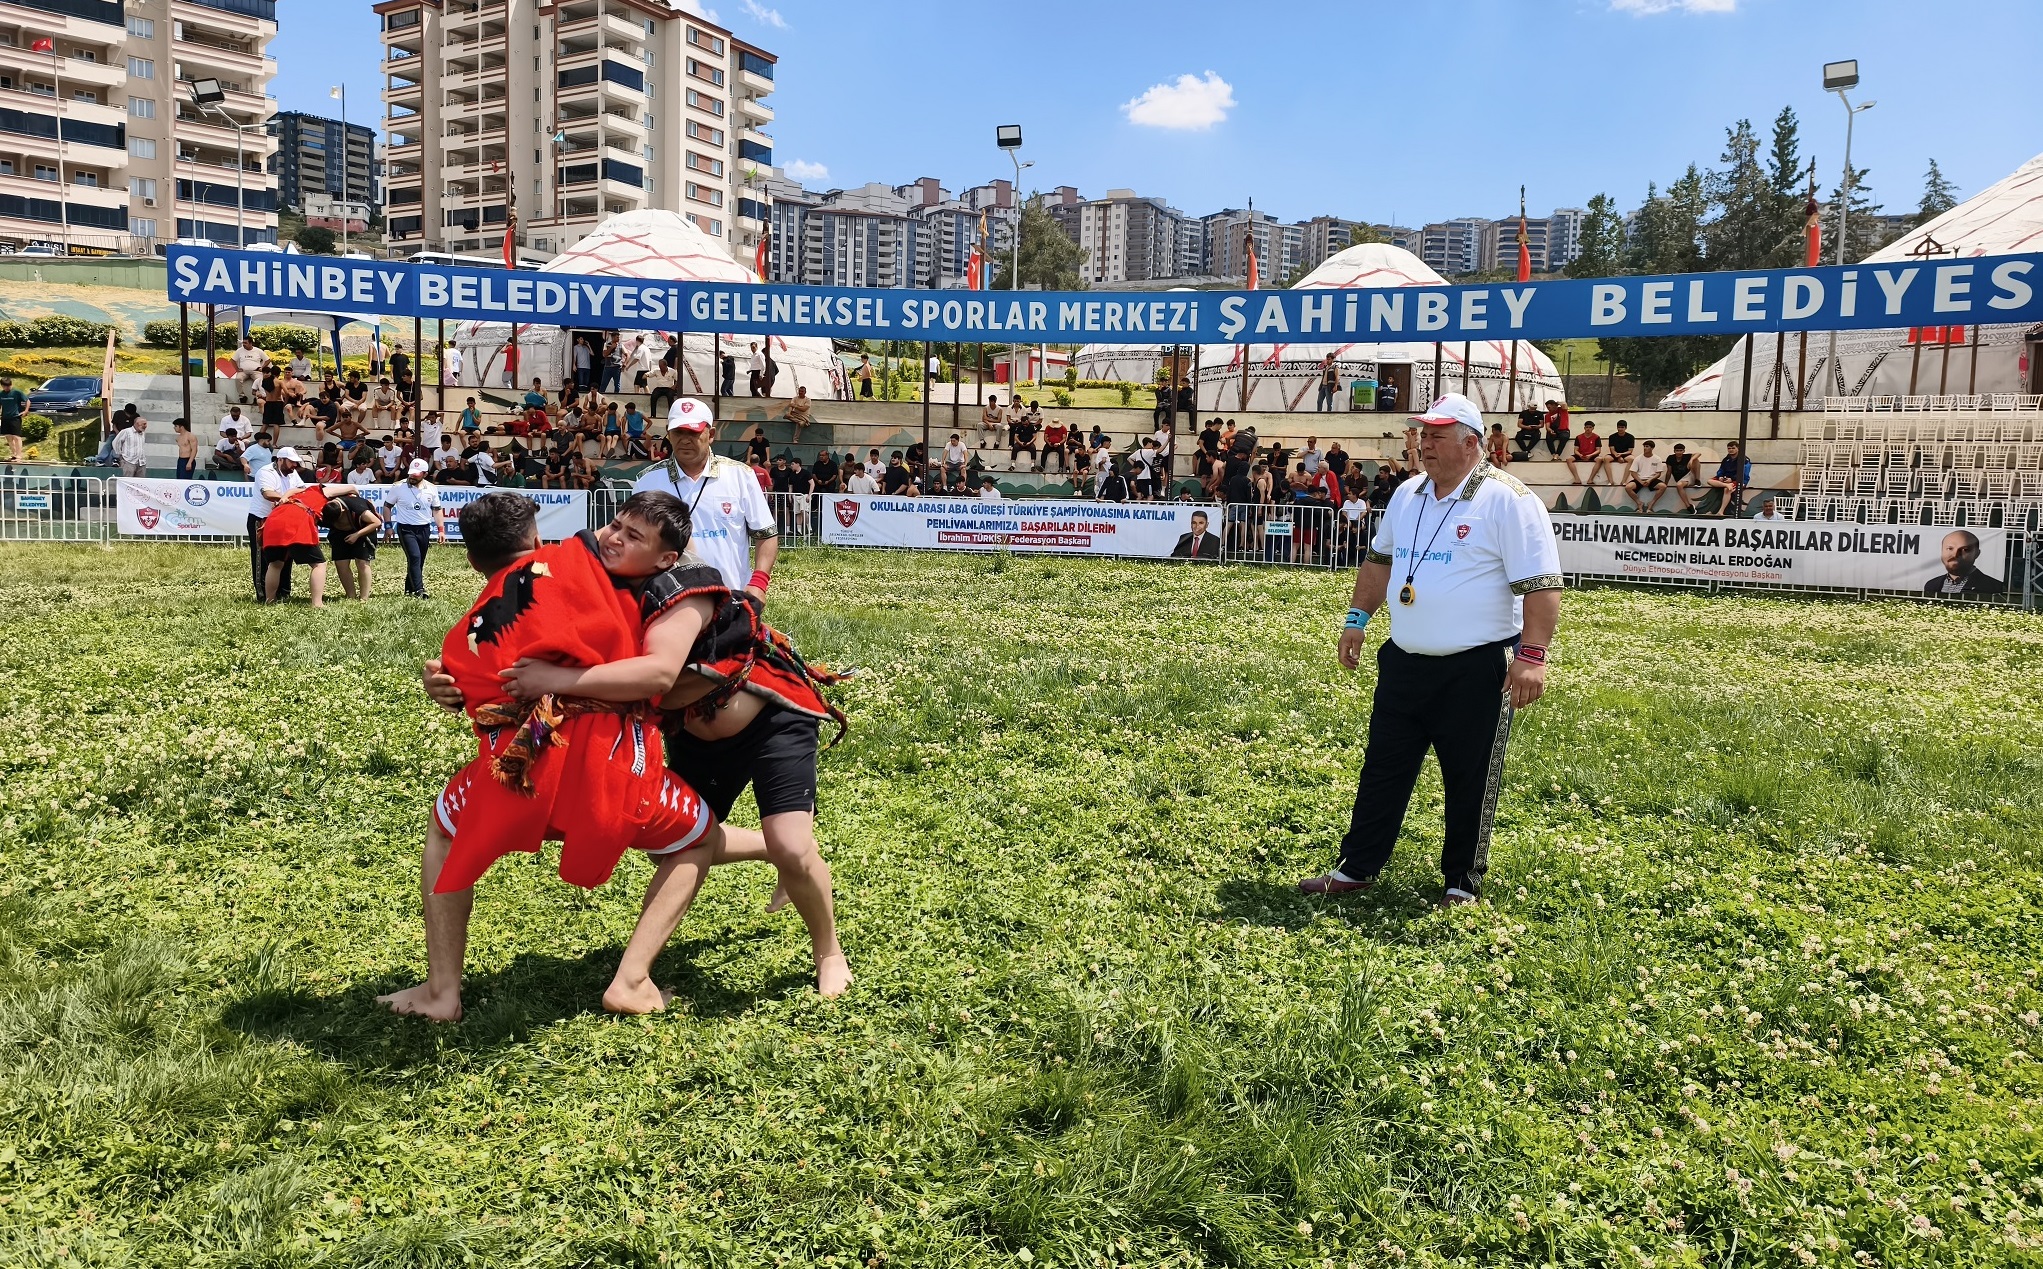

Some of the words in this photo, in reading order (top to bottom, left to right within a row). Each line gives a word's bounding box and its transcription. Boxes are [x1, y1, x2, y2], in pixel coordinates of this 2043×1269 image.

[690, 291, 890, 328] GELENEKSEL
[901, 299, 1047, 331] SPORLAR
[870, 500, 915, 513] OKULLAR
[917, 503, 946, 514] ARASI
[948, 504, 969, 515] ABA
[971, 503, 1006, 517] GÜREŞİ
[1008, 504, 1048, 517] TÜRKİYE
[1050, 505, 1131, 520] ŞAMPİYONASINA
[1132, 509, 1176, 522] KATILAN
[926, 517, 1019, 532] PEHLİVANLARIMIZA
[1021, 521, 1076, 533] BAŞARILAR
[1077, 521, 1116, 535] DİLERİM
[939, 531, 970, 541] İbrahim
[1010, 535, 1056, 545] Federasyon
[1058, 536, 1090, 546] Başkanı
[1724, 528, 1833, 552] BAŞARILAR
[1838, 528, 1920, 555] DİLERİM
[1395, 547, 1409, 558] CW
[1421, 550, 1452, 564] Enerji
[1615, 550, 1687, 564] NECMEDDİN
[1689, 551, 1726, 566] BİLAL
[1728, 554, 1792, 569] ERDOĞAN
[1623, 564, 1647, 574] Dünya
[1648, 565, 1684, 575] Etnospor
[1685, 567, 1750, 579] Konfederasyonu
[1751, 570, 1783, 580] Başkanı
